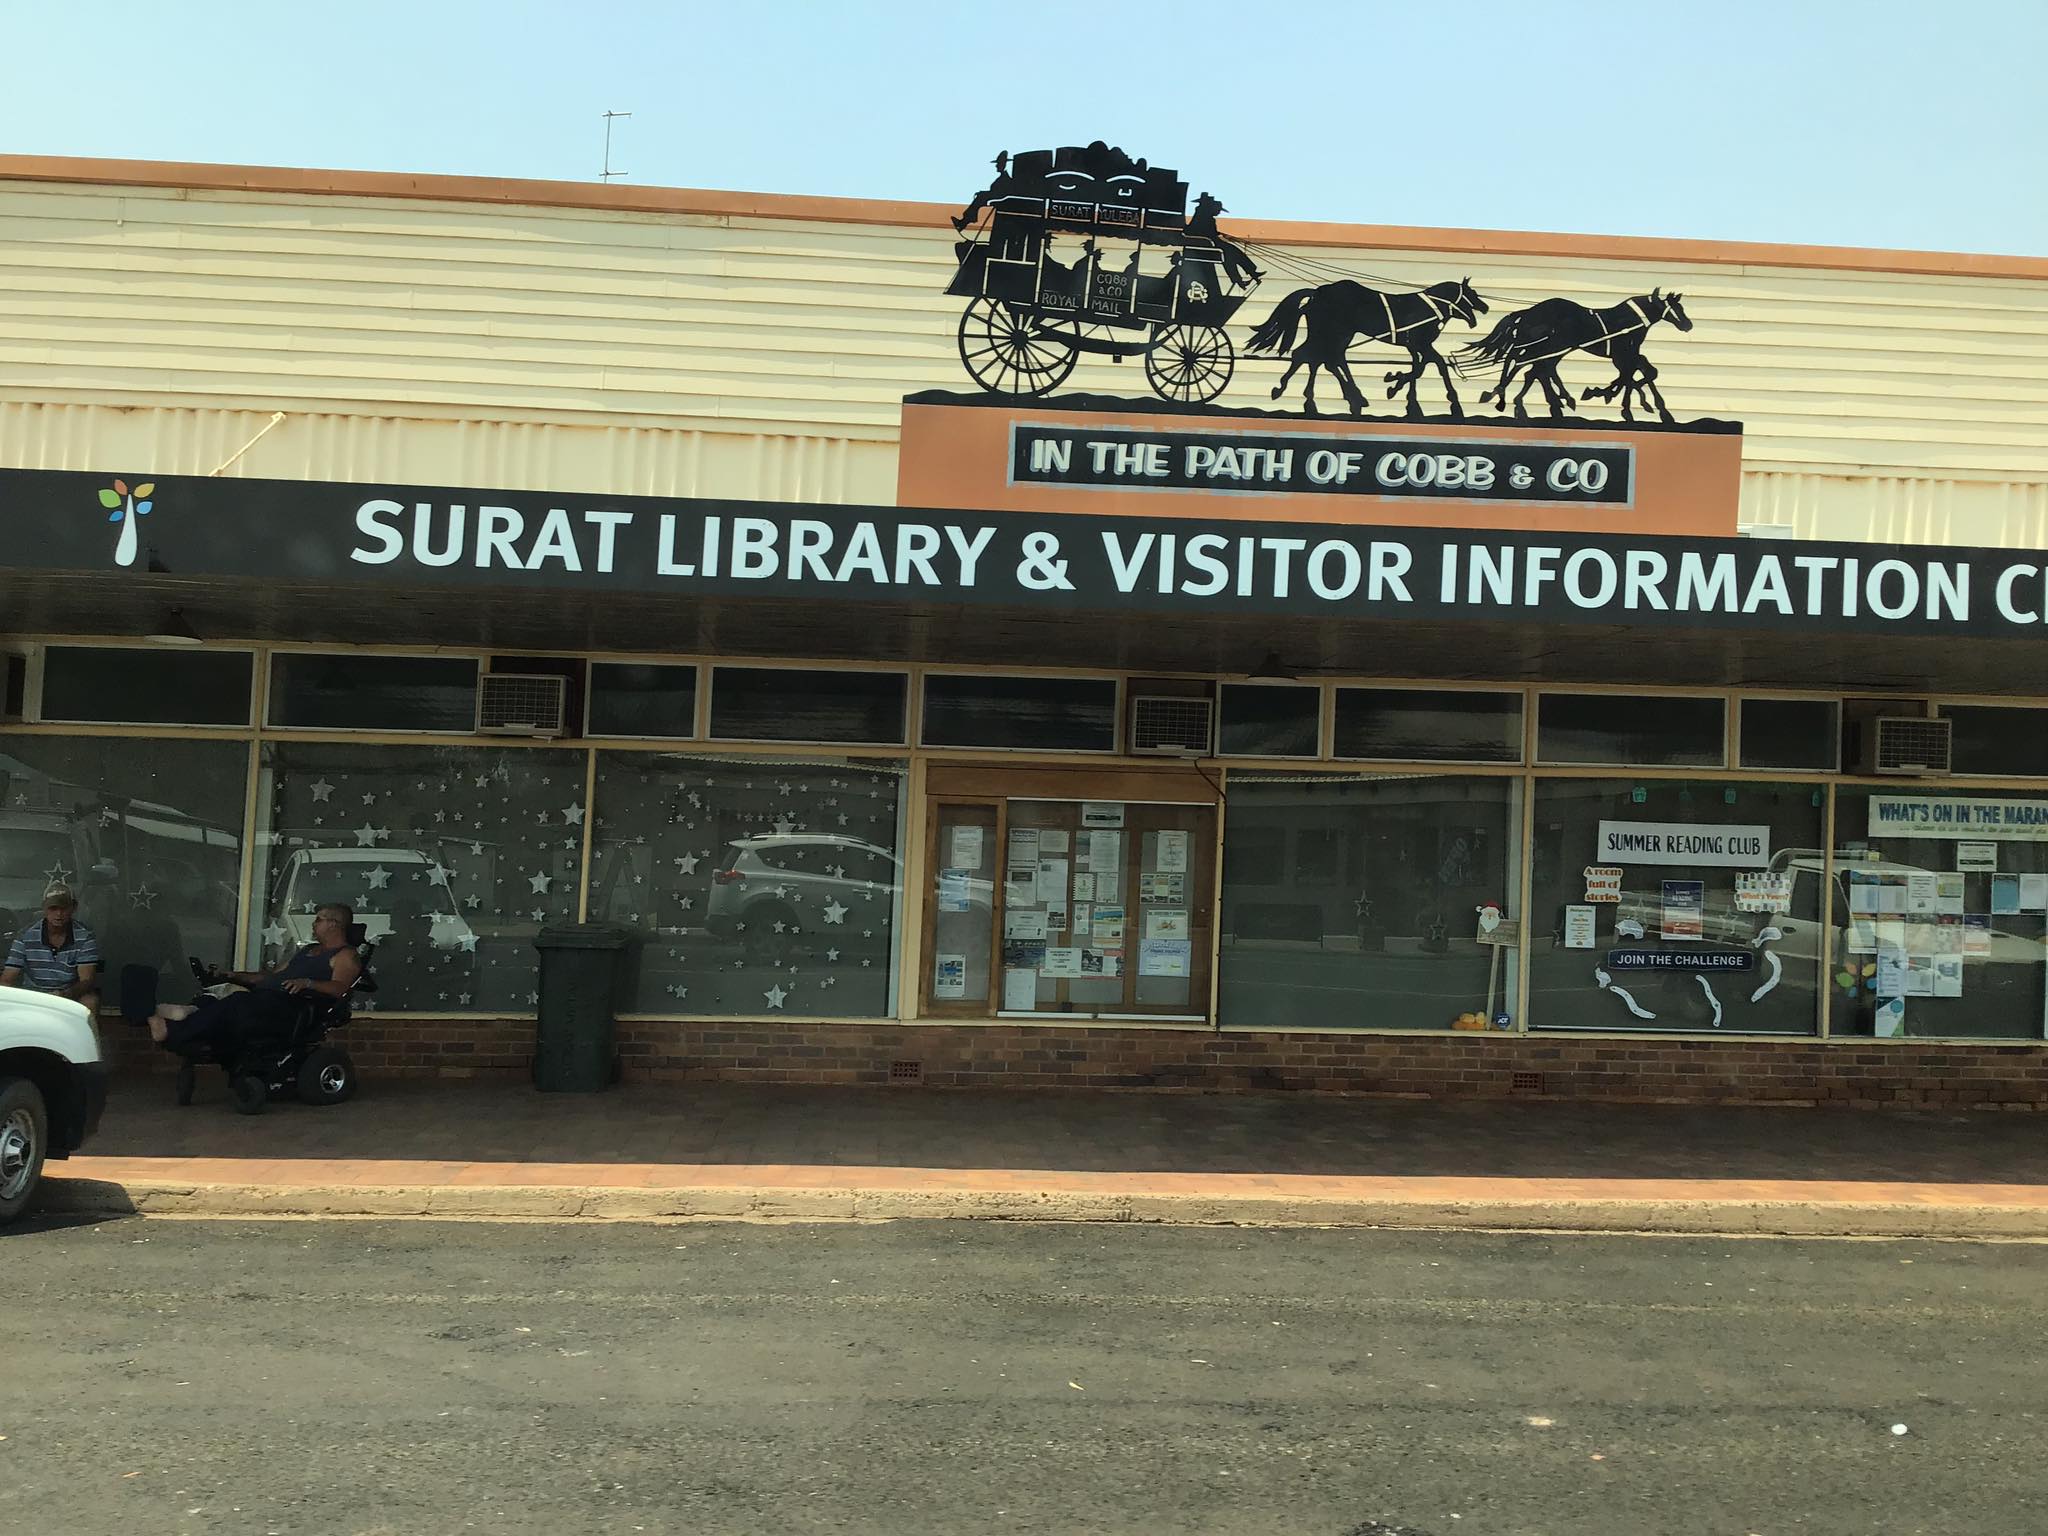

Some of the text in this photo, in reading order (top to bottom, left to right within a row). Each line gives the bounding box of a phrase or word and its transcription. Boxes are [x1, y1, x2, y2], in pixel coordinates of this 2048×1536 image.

[1051, 204, 1091, 219] SURAT
[1098, 208, 1139, 224] YULEBA
[1096, 273, 1127, 287] COBB
[1107, 286, 1122, 297] CO
[1042, 292, 1121, 314] ROYAL MAIL
[1030, 438, 1608, 492] IN THE PATH OF COBB & CO
[350, 499, 2048, 624] SURAT LIBRARY & VISITOR INFORMATION C
[1879, 803, 1929, 822] WHAT'S
[1933, 804, 1952, 822] ON
[1956, 805, 1970, 823] IN
[1974, 805, 2000, 823] THE
[1607, 832, 1761, 856] SUMMER READING CLUB
[1585, 867, 1592, 876] A
[1586, 893, 1619, 902] stories
[1617, 954, 1744, 966] JOIN THE CHALLENGE
